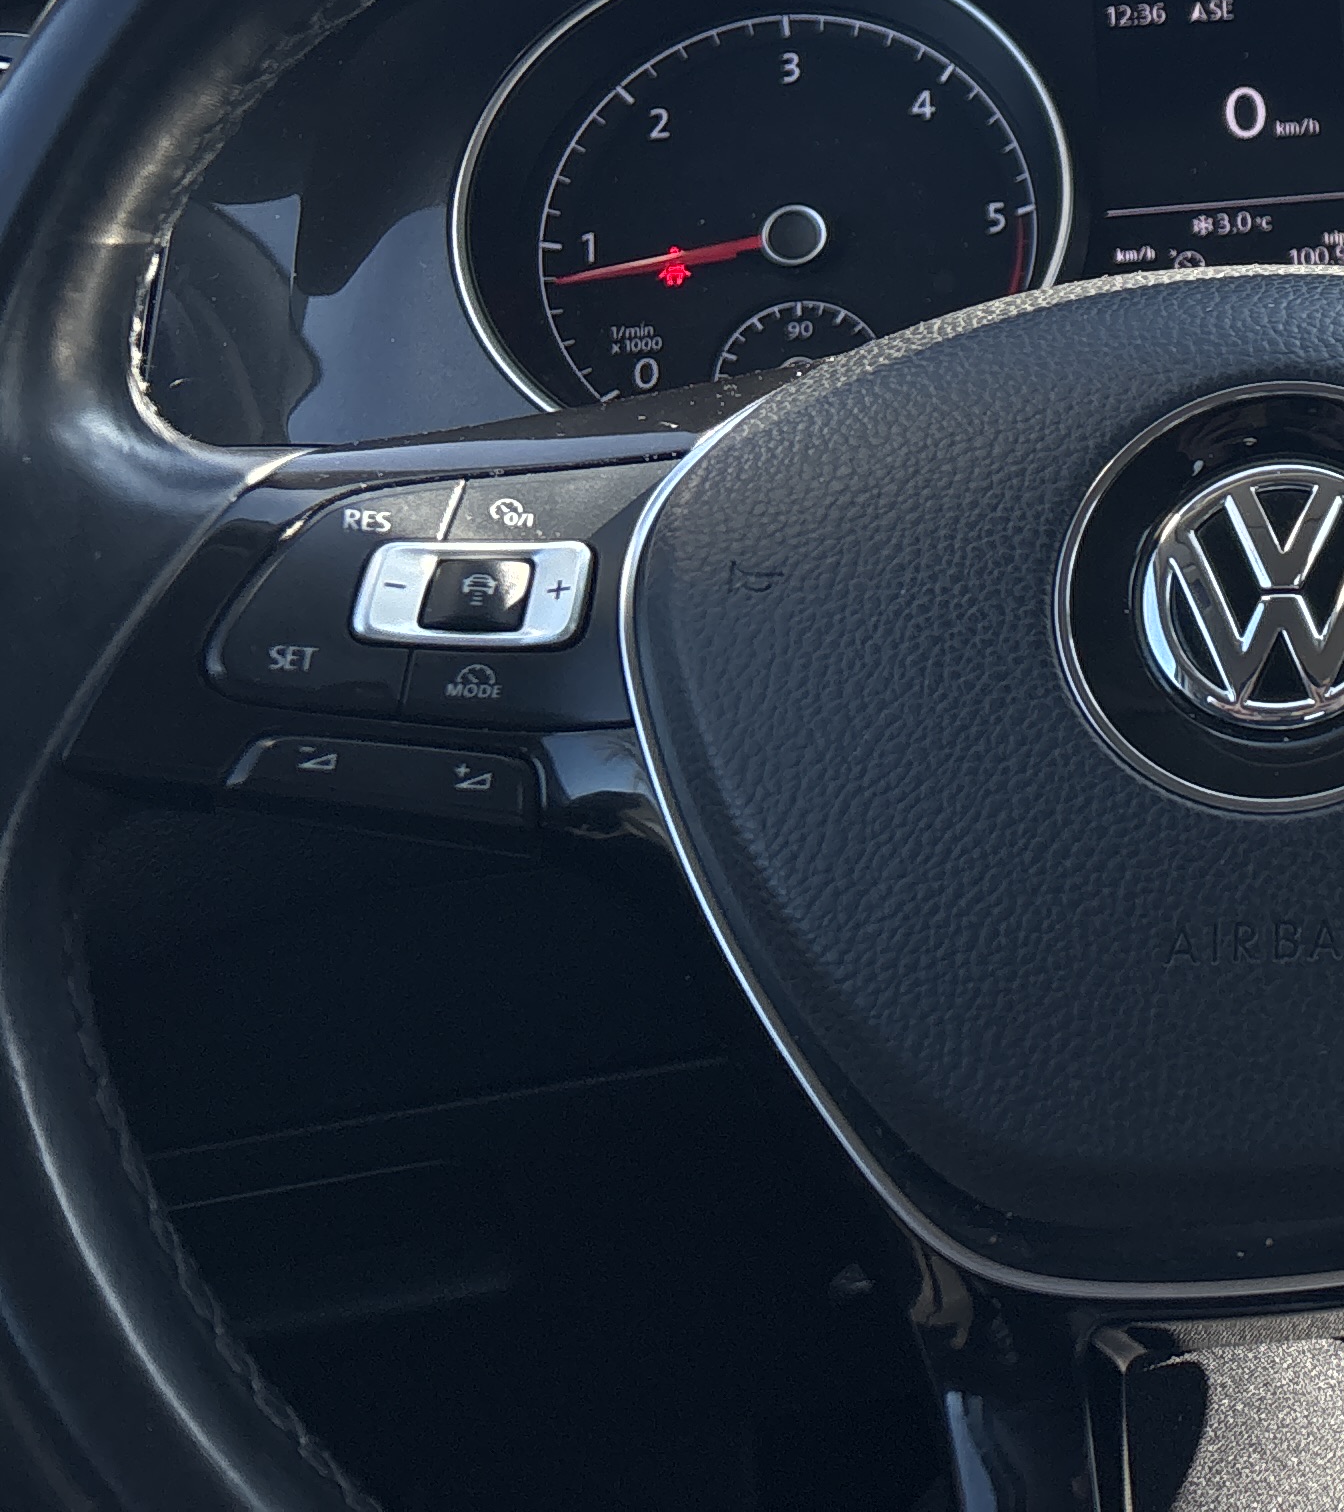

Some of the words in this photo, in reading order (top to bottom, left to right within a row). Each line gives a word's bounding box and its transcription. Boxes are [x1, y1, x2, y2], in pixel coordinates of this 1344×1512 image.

[1105, 1, 1167, 28] 12:36
[781, 51, 801, 85] 3
[909, 90, 936, 121] 4
[1225, 86, 1267, 139] 0
[1275, 118, 1320, 138] km/h
[648, 108, 671, 141] 2
[984, 201, 1006, 235] 5
[581, 232, 597, 263] 1
[1114, 244, 1156, 264] km/h
[611, 321, 655, 340] 1/min
[786, 320, 814, 340] 90
[626, 337, 663, 353] 1000
[634, 357, 660, 389] 0
[342, 508, 392, 533] RES
[268, 644, 320, 673] SET
[445, 682, 503, 700] MODE
